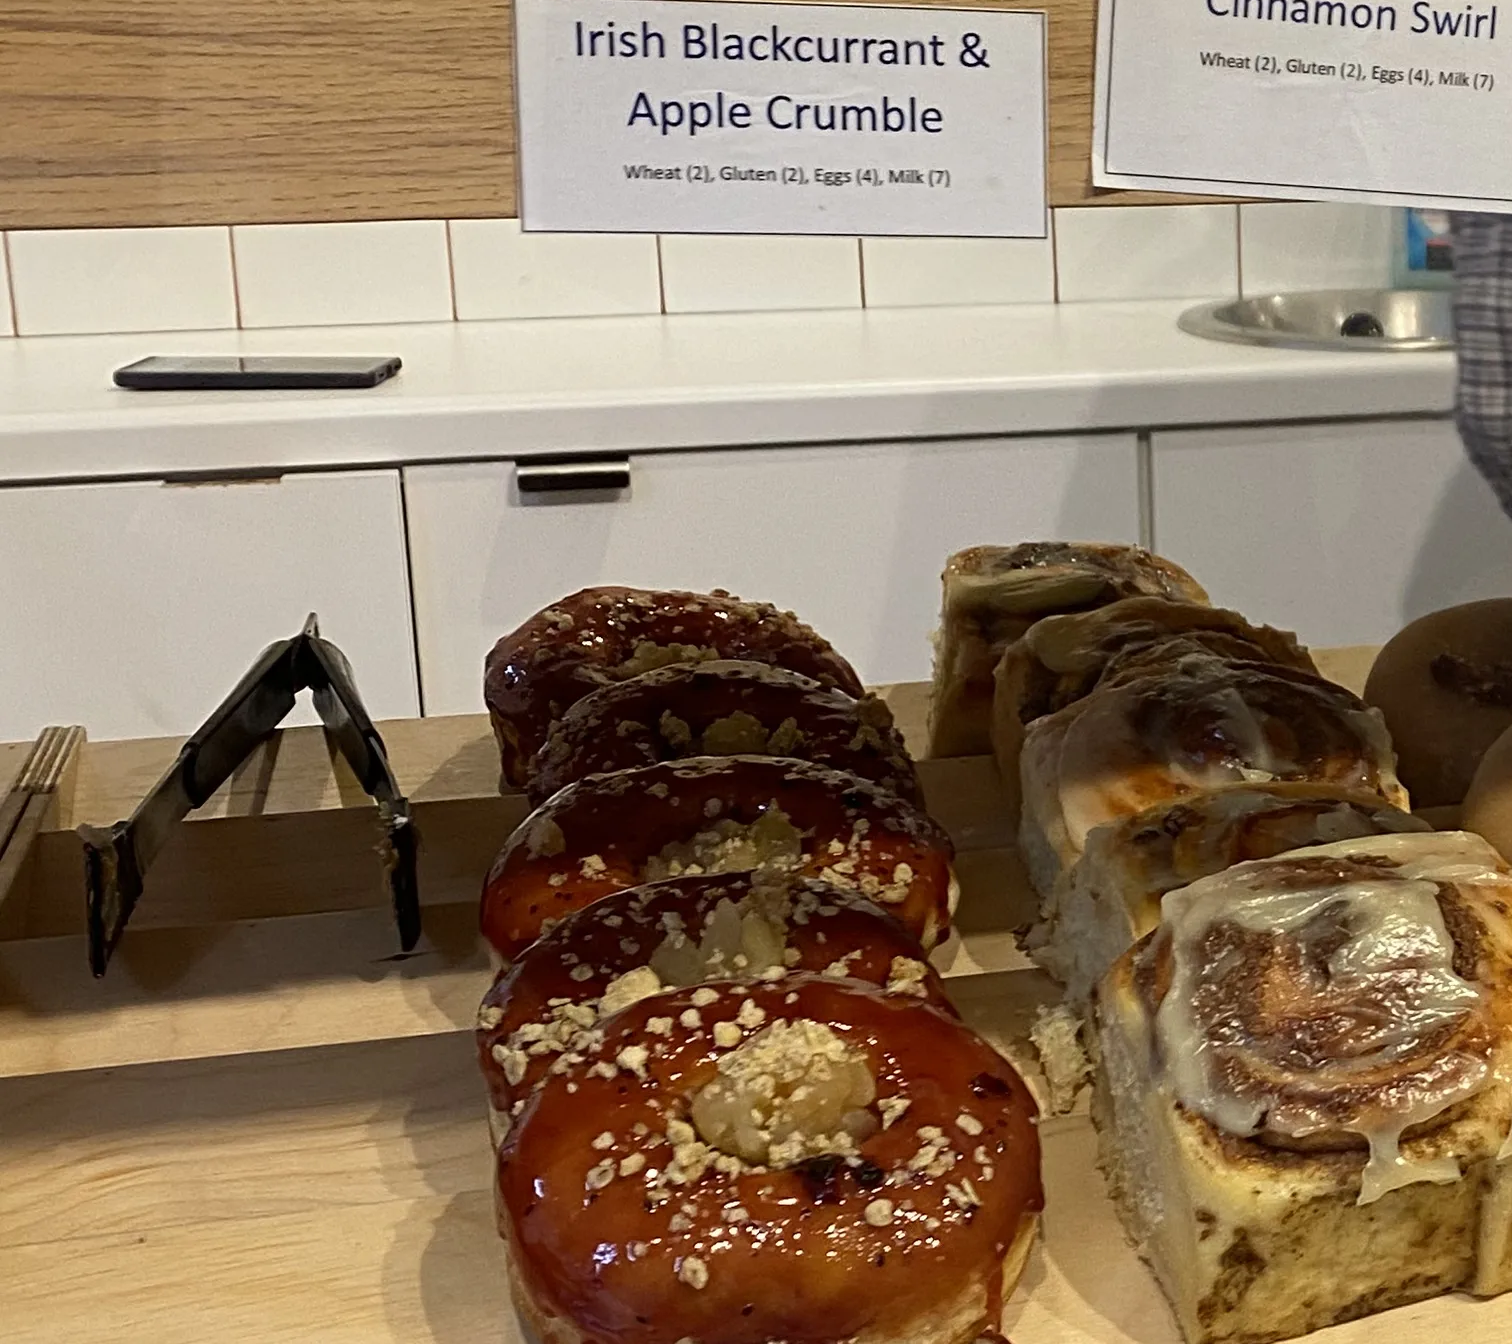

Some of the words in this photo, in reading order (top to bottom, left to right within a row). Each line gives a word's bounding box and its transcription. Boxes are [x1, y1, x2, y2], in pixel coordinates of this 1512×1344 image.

[1410, 0, 1498, 41] Swirl
[574, 20, 666, 59] Irish
[682, 23, 945, 67] Blackcurrant
[958, 32, 991, 69] &
[1200, 51, 1251, 72] Wheat
[1254, 55, 1282, 76] (2),
[1285, 57, 1337, 78] Gluten
[1340, 61, 1367, 82] (2),
[1371, 64, 1405, 86] Eggs
[1407, 67, 1434, 88] (4),
[1438, 70, 1470, 89] Milk
[1473, 72, 1496, 92] (7)
[628, 91, 752, 136] Apple
[766, 94, 944, 135] Crumble
[622, 163, 683, 183] Wheat
[686, 164, 714, 185] (2),
[718, 164, 778, 184] Gluten
[781, 165, 809, 187] (2),
[814, 168, 853, 188] Eggs
[855, 168, 884, 188] (4),
[888, 168, 926, 187] Milk
[928, 169, 951, 189] (7)
